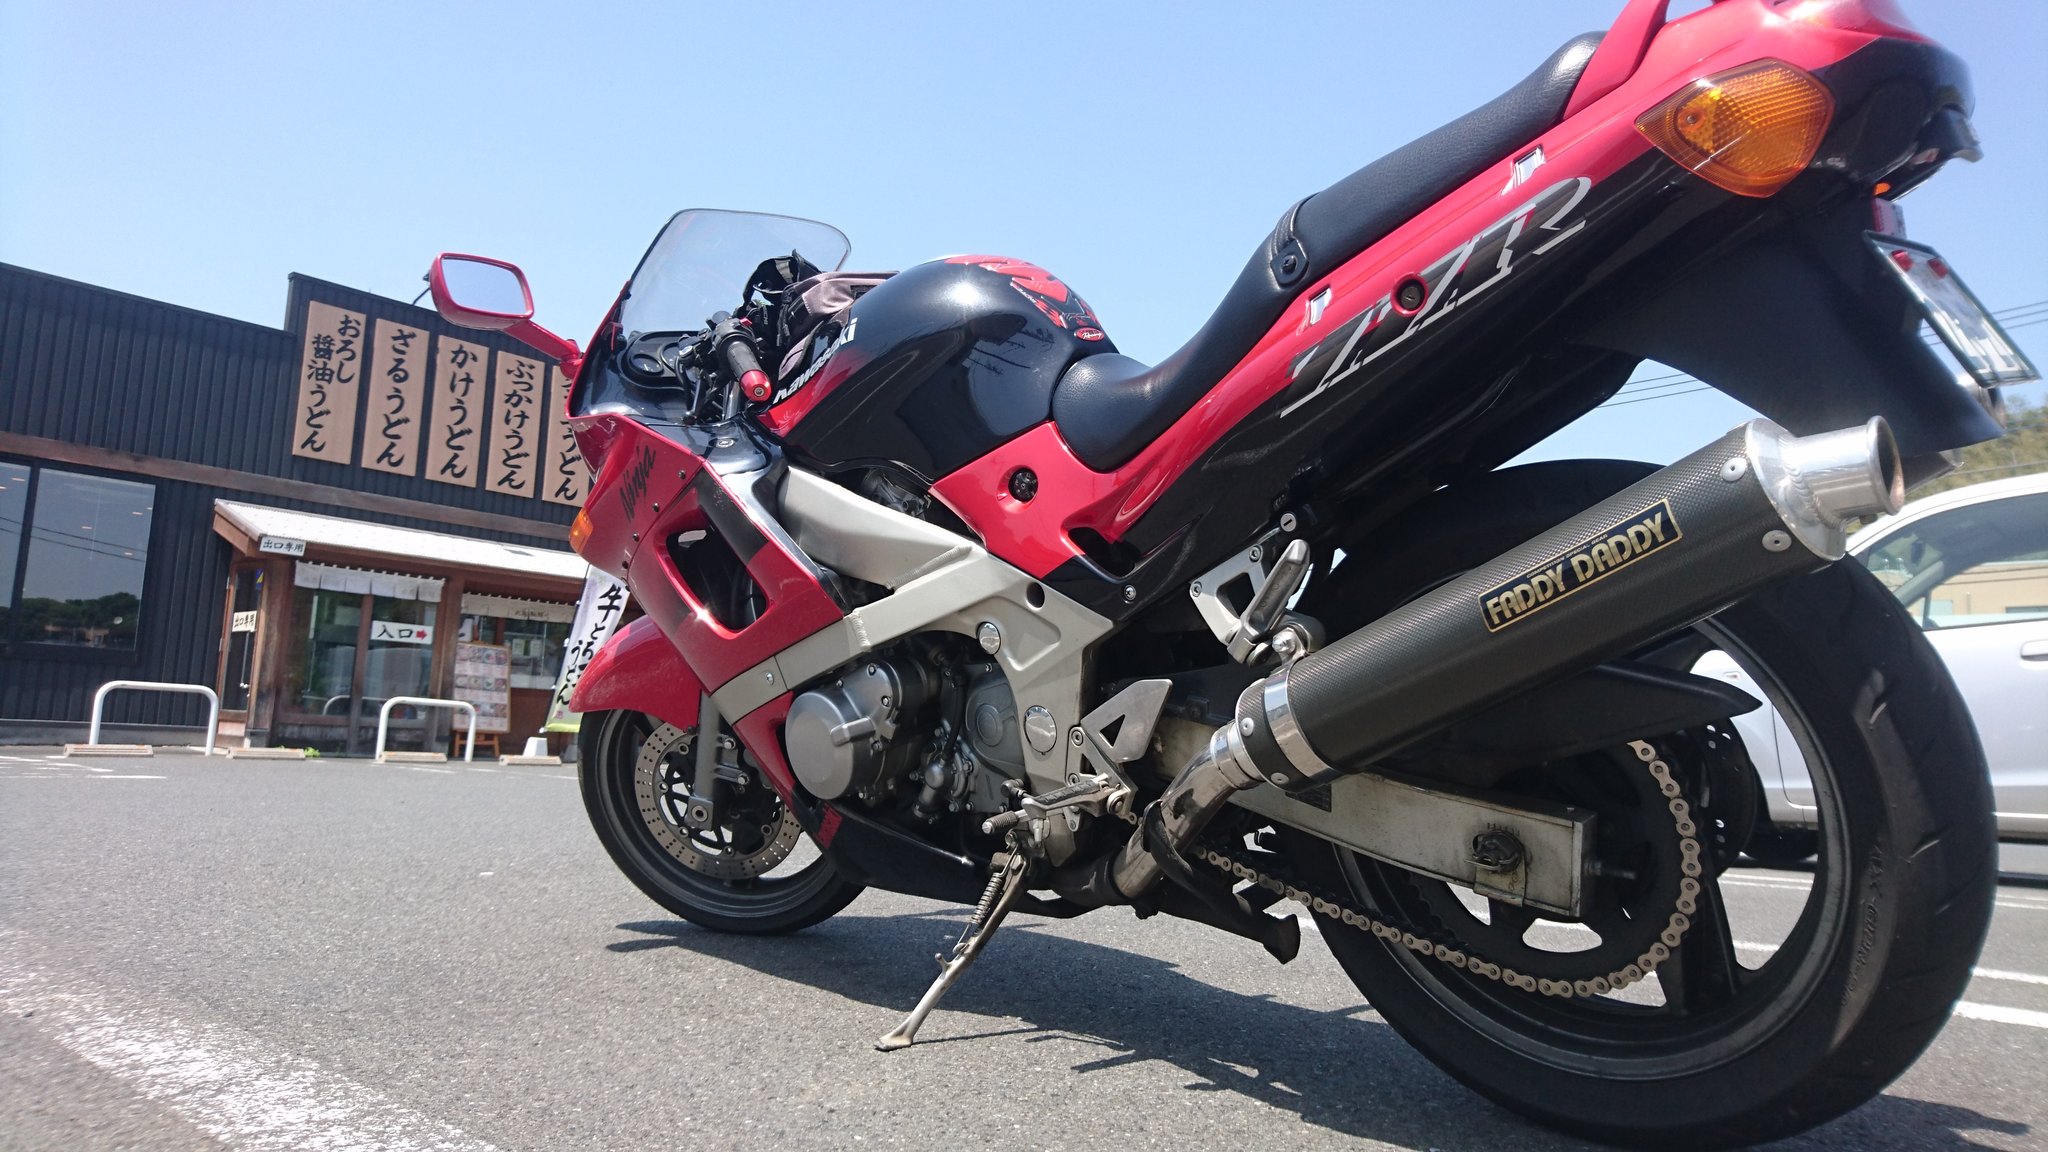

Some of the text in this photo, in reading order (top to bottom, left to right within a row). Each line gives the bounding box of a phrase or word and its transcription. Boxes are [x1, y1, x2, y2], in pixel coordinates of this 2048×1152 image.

[301, 333, 335, 452] 醤油うどん
[337, 314, 361, 383] おろし
[376, 329, 417, 467] ざるうどん
[440, 344, 478, 478] かけうどん
[497, 360, 535, 489] ぶっかけうどん
[620, 445, 657, 522] Ninja
[263, 539, 304, 552] 出口専用
[1486, 512, 1666, 625] FADDY DADDY
[377, 624, 413, 639] 入口
[557, 640, 583, 705] うどん
